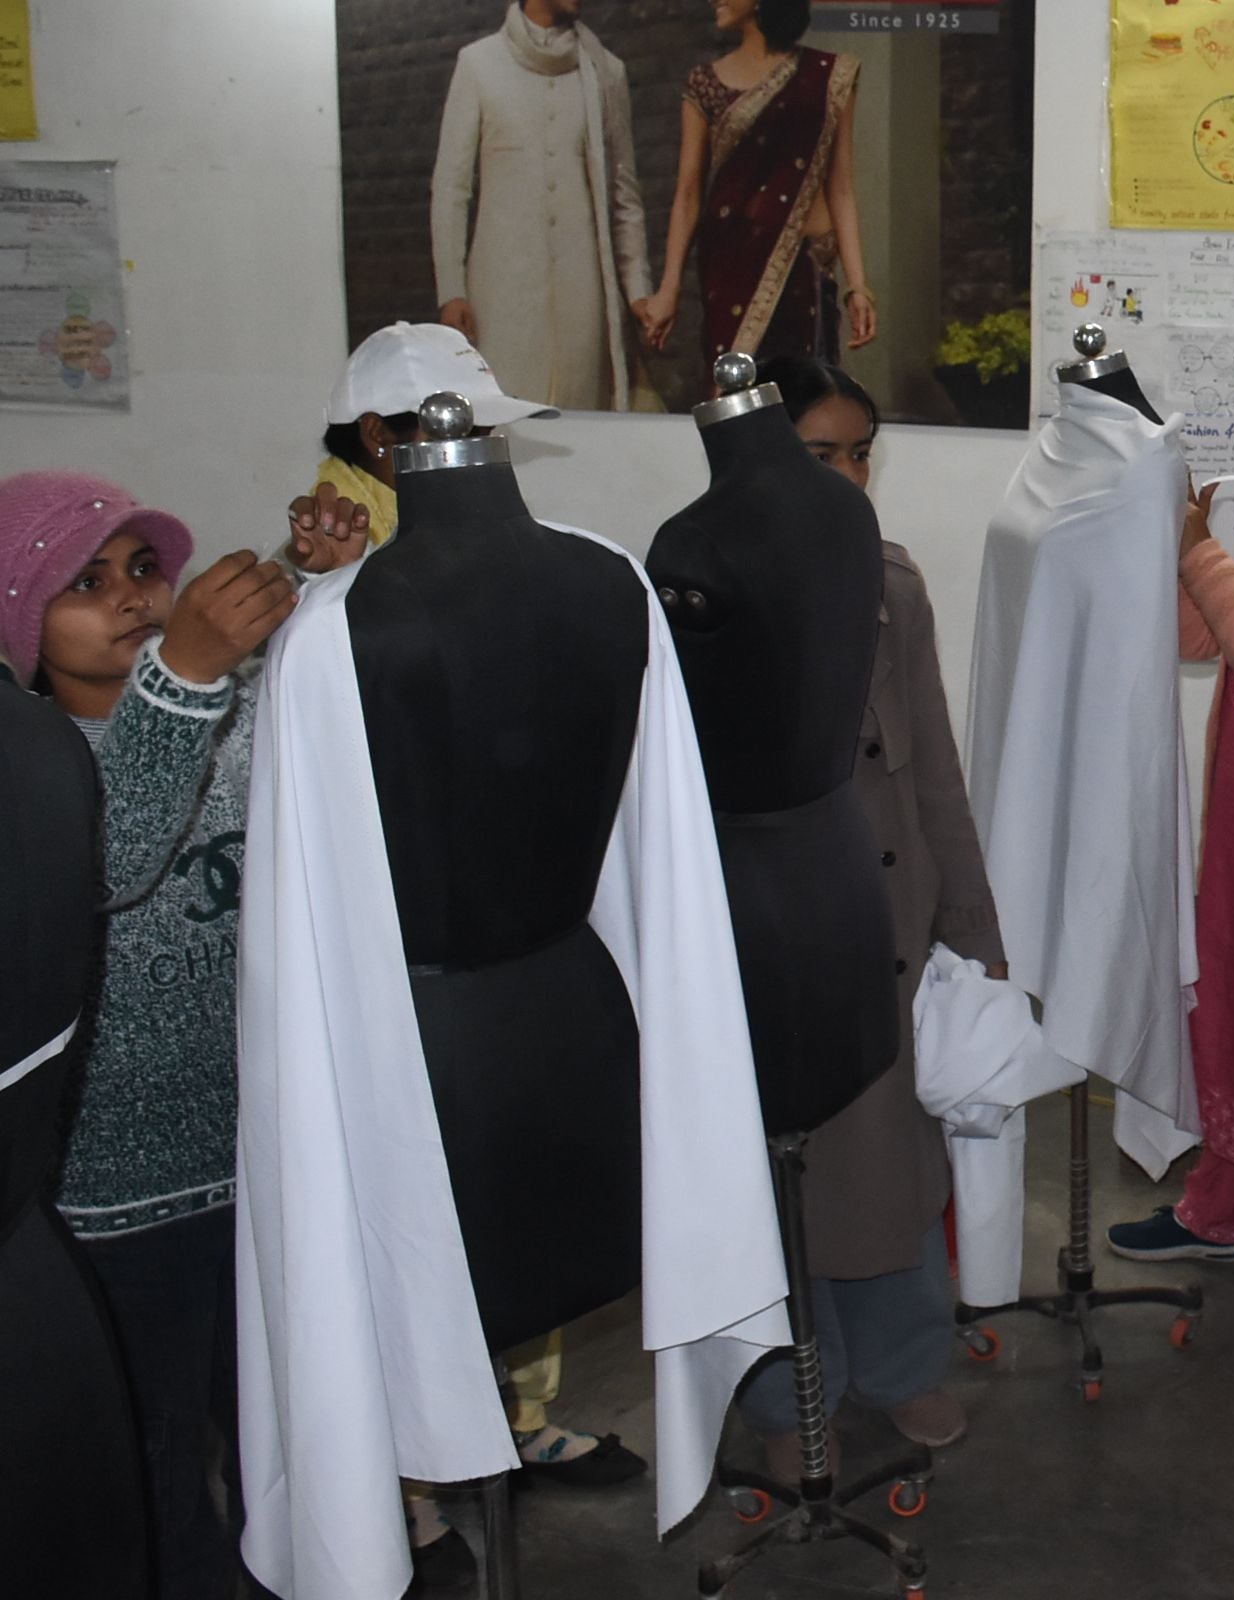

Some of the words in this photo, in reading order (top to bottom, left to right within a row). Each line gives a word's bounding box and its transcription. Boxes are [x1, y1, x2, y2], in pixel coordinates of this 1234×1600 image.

[849, 12, 903, 28] Since
[916, 12, 960, 29] 1925
[149, 935, 238, 988] CHA
